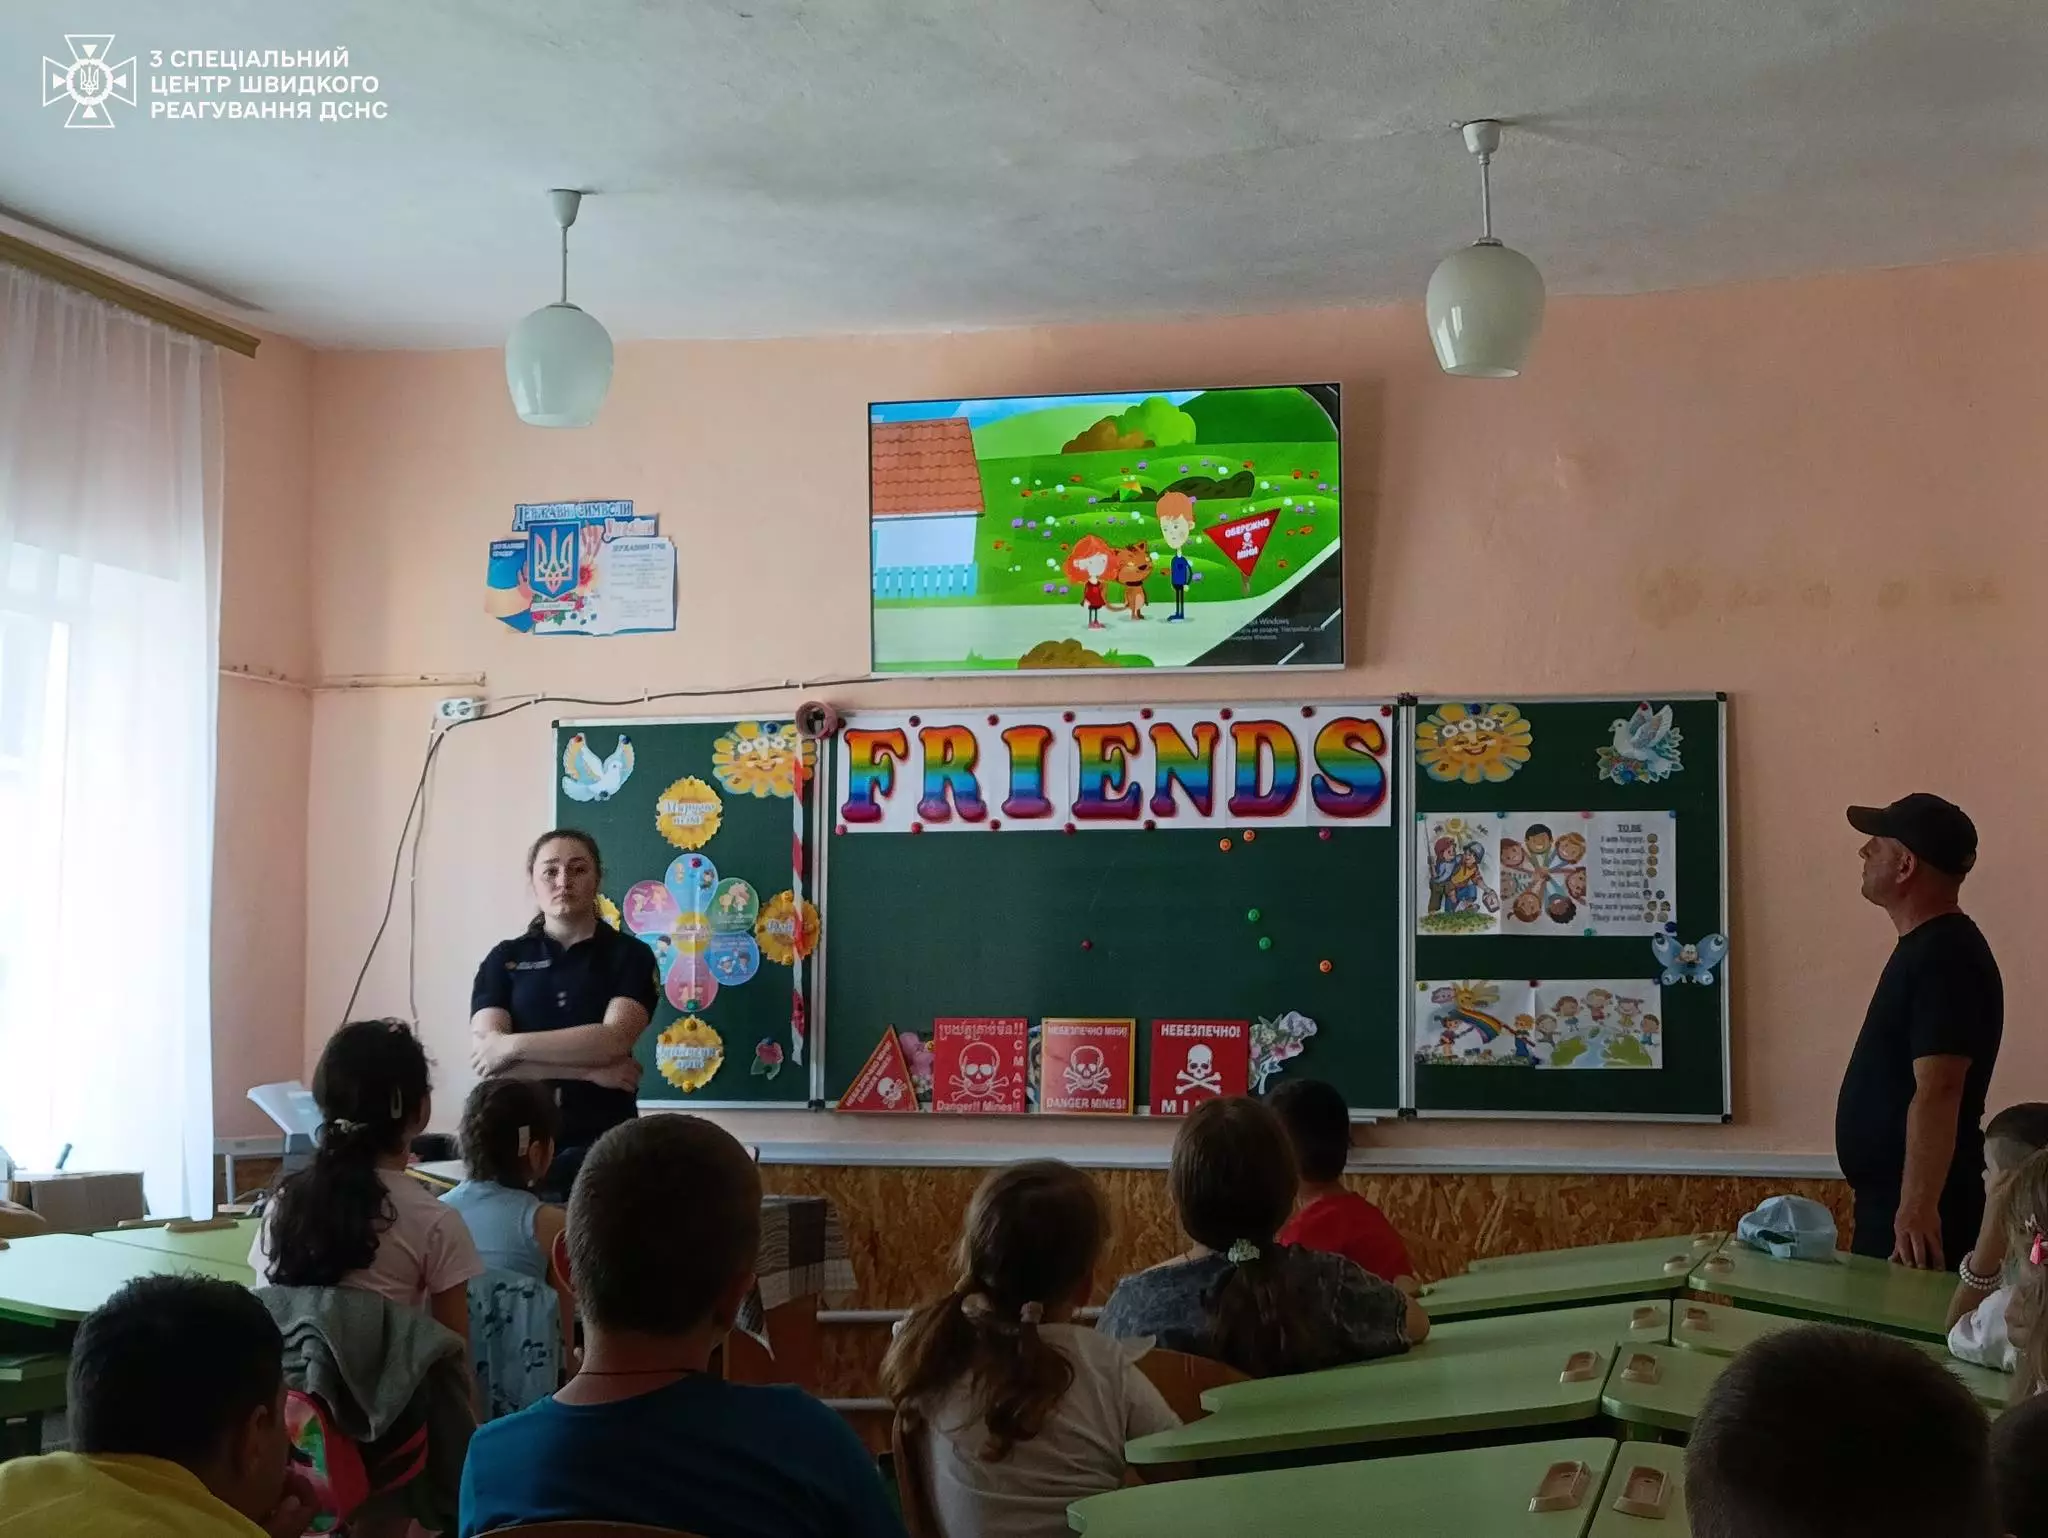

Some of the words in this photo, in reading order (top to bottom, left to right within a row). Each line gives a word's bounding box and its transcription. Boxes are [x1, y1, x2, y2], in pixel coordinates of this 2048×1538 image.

[1225, 518, 1270, 538] ОБЕРЕЖНО
[841, 718, 1387, 824] FRIENDS
[1161, 1024, 1241, 1038] НЕБЕЗПЕЧНО!
[1046, 1098, 1090, 1109] DANGER
[1091, 1098, 1126, 1110] MINES!
